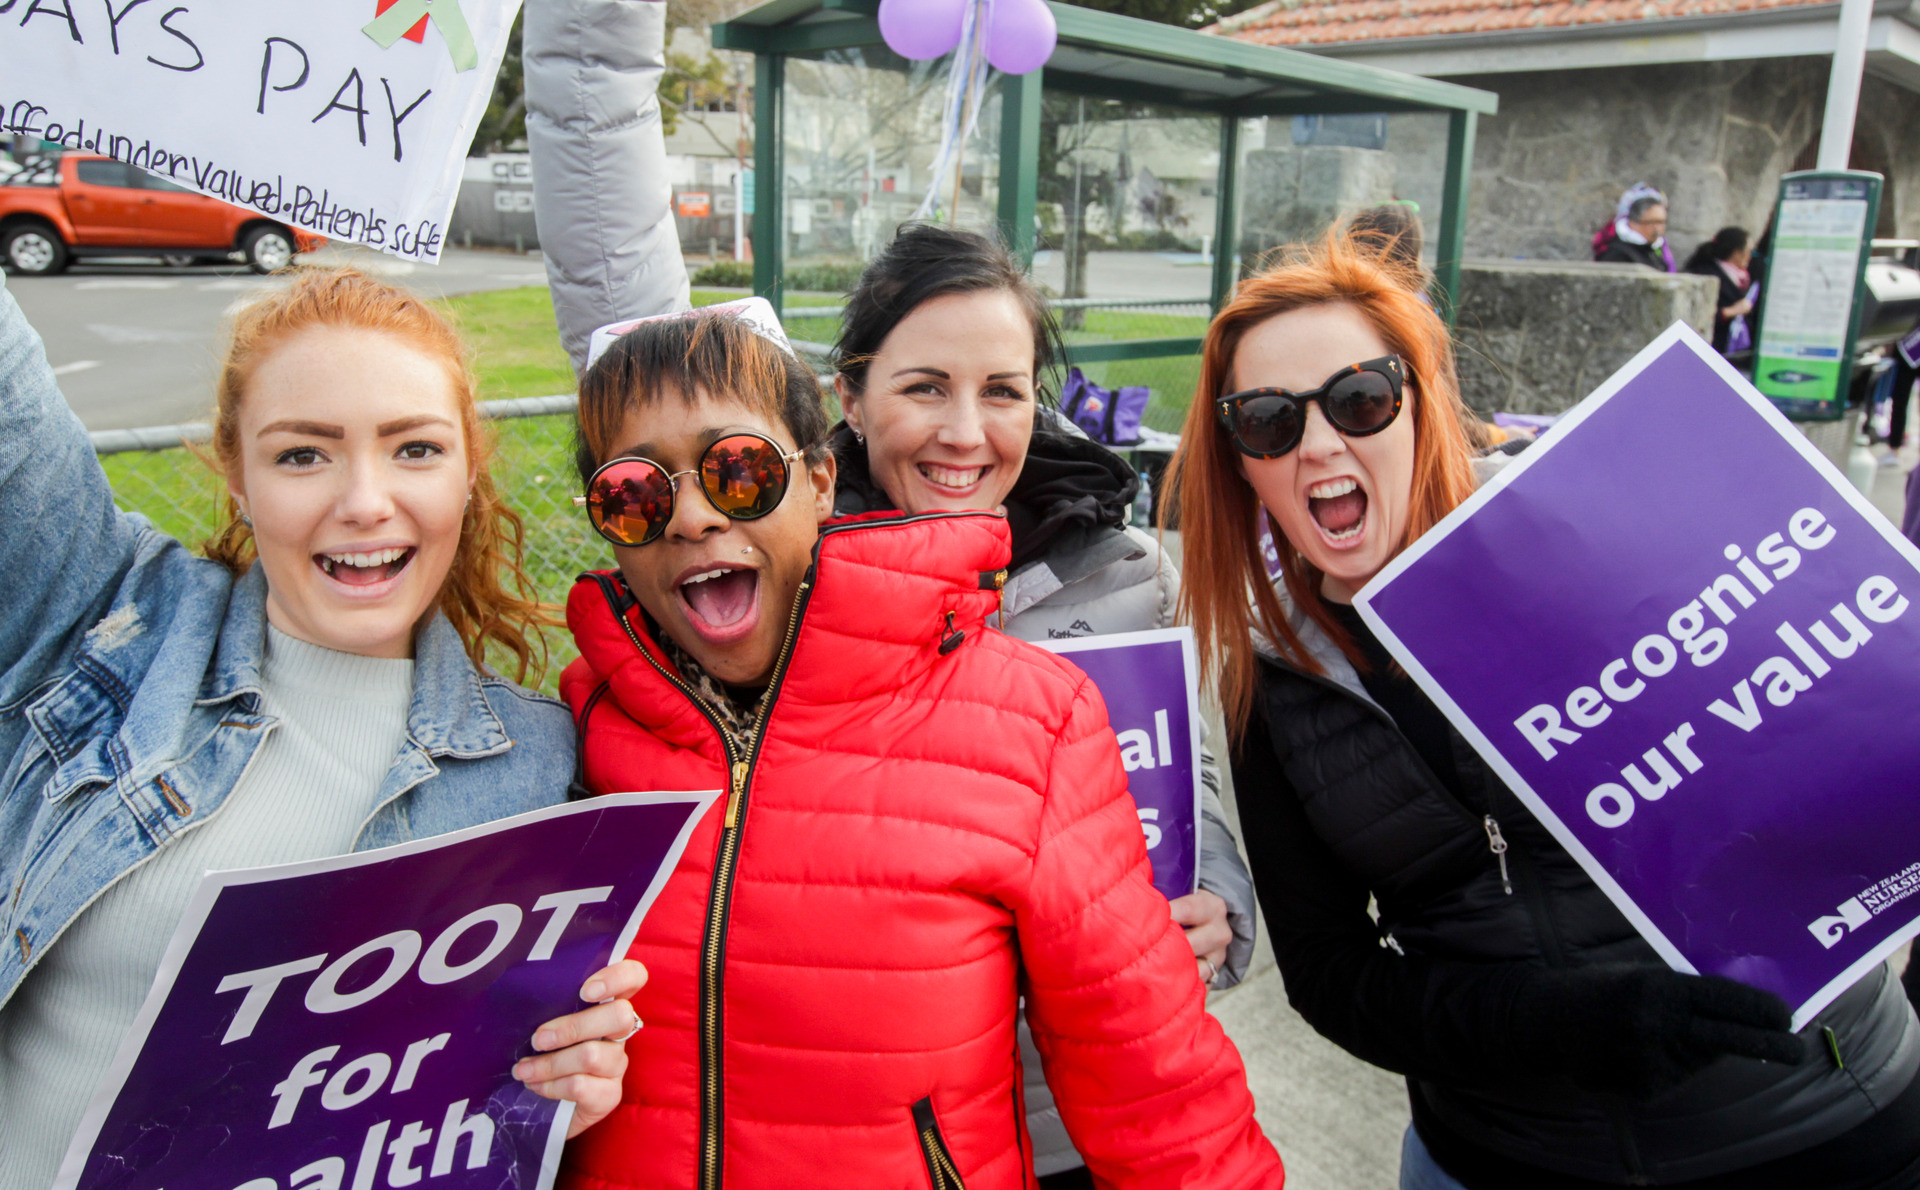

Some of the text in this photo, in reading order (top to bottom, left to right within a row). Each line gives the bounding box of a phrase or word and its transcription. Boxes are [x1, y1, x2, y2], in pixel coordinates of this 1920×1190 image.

[0, 0, 431, 162] AYS PAY
[1513, 507, 1837, 762] Recognise
[1585, 575, 1910, 828] our value
[1857, 862, 1920, 900] NEW ZEALAND
[1864, 870, 1920, 909] NURSE
[215, 885, 614, 1046] TOOT
[156, 1098, 496, 1190] alth
[267, 1032, 451, 1130] for
